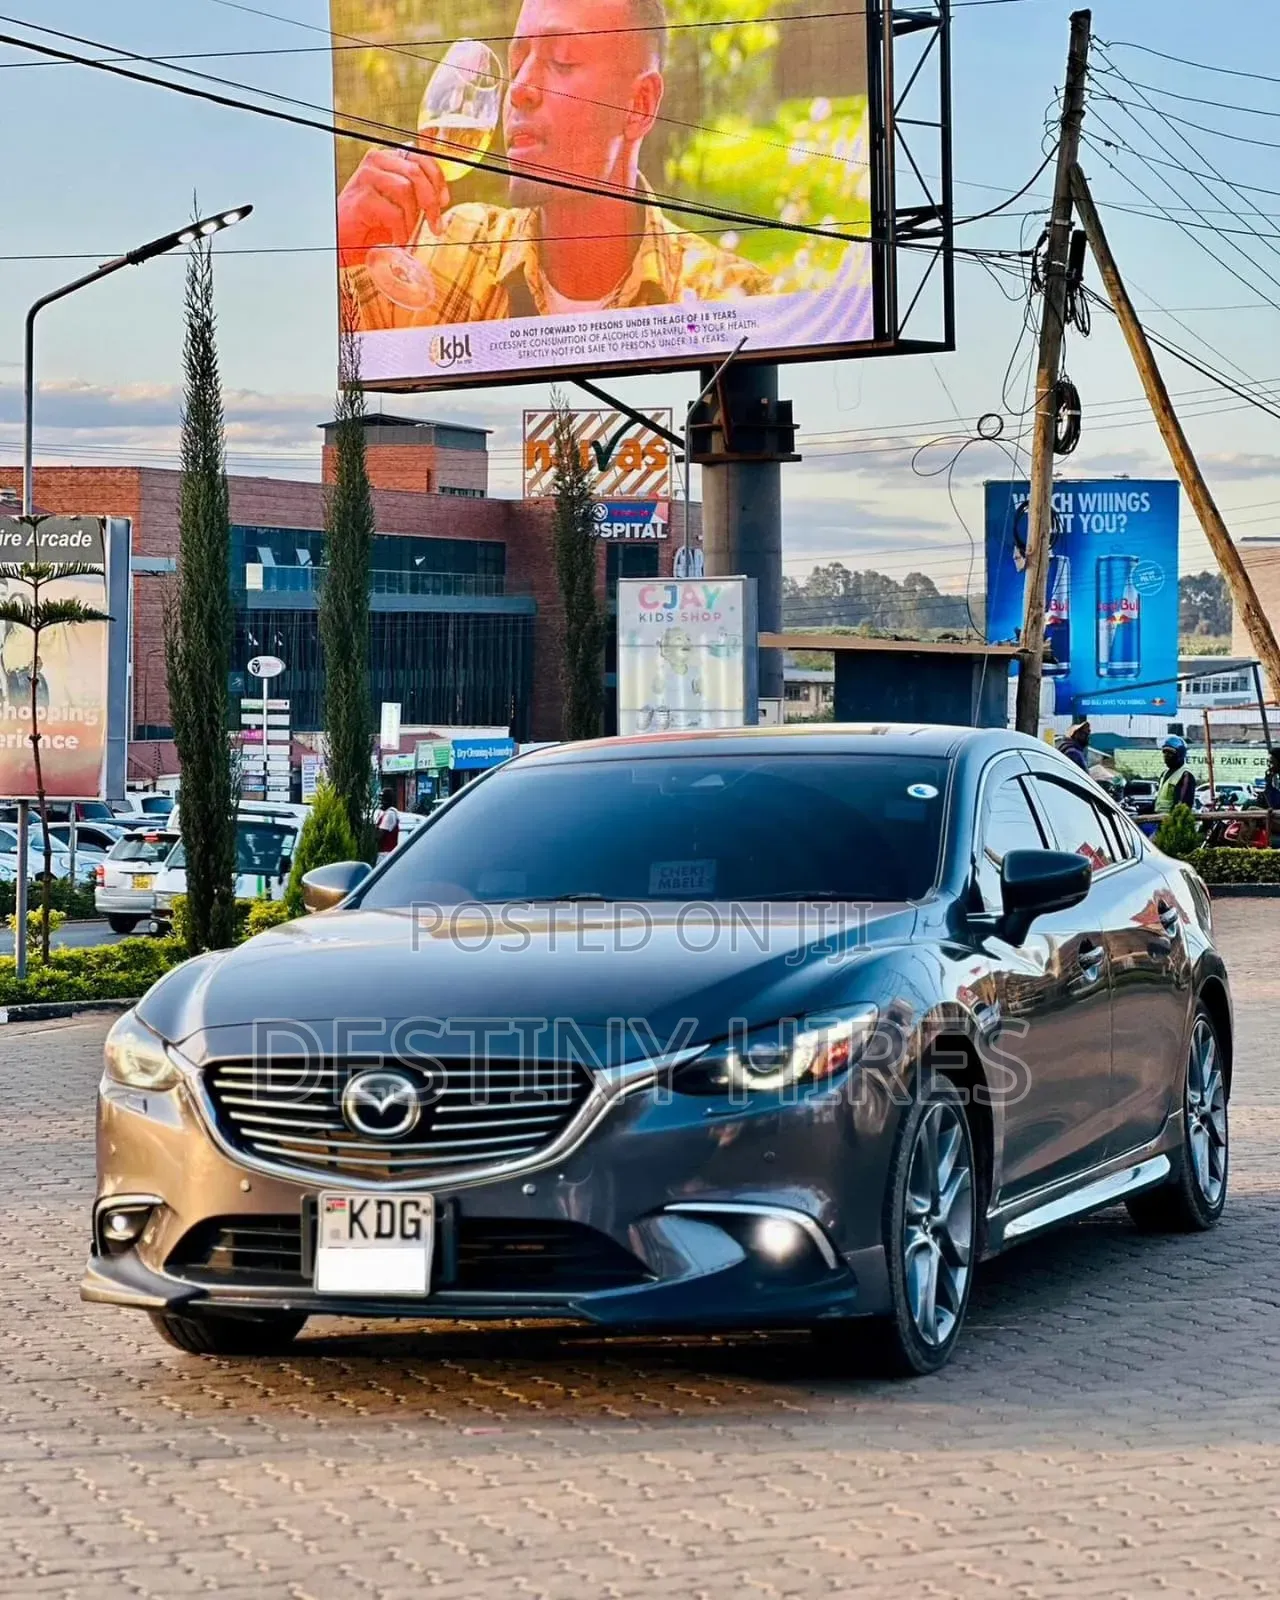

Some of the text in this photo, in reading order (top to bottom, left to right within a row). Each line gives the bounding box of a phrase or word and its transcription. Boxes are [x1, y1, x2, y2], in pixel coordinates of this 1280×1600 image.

[510, 329, 521, 338] DO
[523, 327, 538, 337] NOT
[540, 324, 576, 336] FORWARD
[578, 323, 588, 332] TO
[590, 320, 623, 332] PERSONS
[626, 317, 651, 328] UNDER
[653, 315, 667, 325] THE
[669, 314, 684, 324] AGE
[687, 313, 697, 322] OF
[712, 310, 736, 320] YEARS
[490, 340, 527, 351] EXCESSIVE
[589, 333, 600, 342] OF
[602, 330, 640, 341] ALCOHOL
[518, 348, 548, 359] STRICTLY
[551, 346, 568, 356] NOT
[570, 345, 585, 354] FOR
[587, 344, 605, 353] SALE
[608, 342, 619, 351] TO
[620, 339, 656, 350] PERSONS
[659, 336, 686, 347] UNDER
[1078, 492, 1150, 513] WIIINGS
[1078, 513, 1128, 534] YOU?
[25, 529, 93, 548] Arcade
[638, 584, 721, 611] CJAY
[639, 611, 722, 623] KIDS SHOP
[0, 700, 98, 726] hopping
[1221, 757, 1248, 766] PAINT
[348, 1199, 421, 1241] KDG
